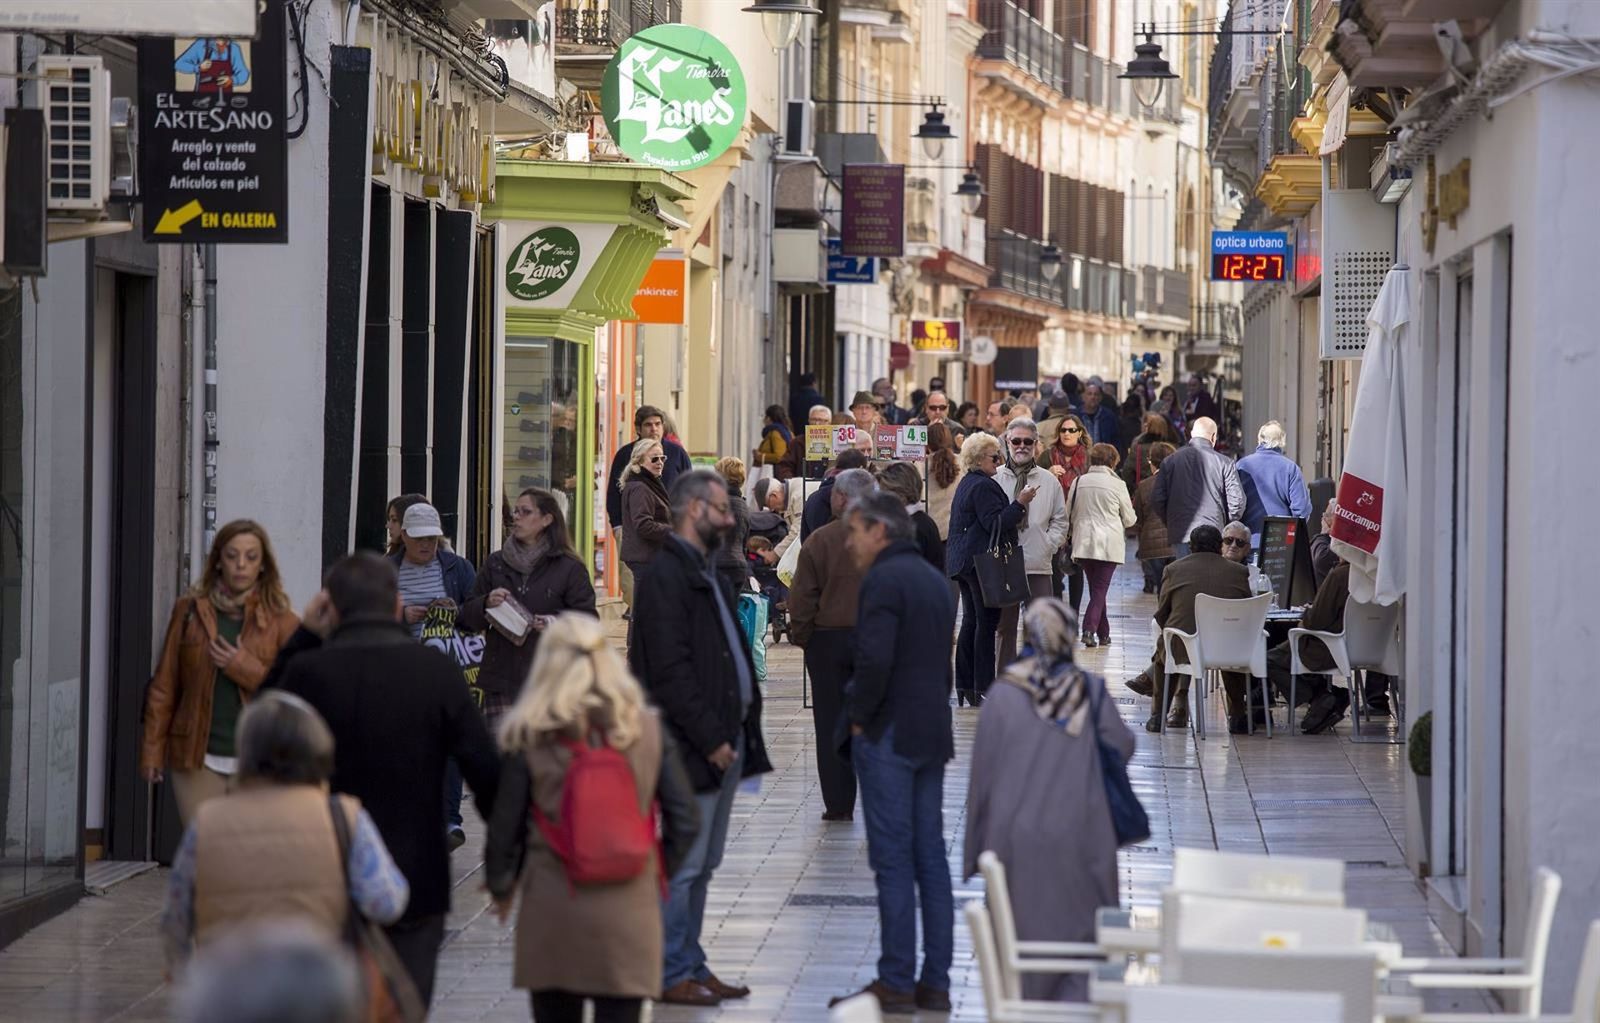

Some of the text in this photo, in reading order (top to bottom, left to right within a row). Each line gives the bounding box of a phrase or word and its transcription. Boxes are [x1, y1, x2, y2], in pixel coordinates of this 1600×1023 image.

[686, 61, 732, 79] Tiendas
[156, 92, 181, 109] EL
[154, 107, 273, 133] ARTESANO
[171, 138, 257, 156] Arreglo y venta
[182, 157, 246, 172] del calzado
[641, 151, 680, 166] Fundada
[169, 174, 260, 192] Artículos en piel
[201, 212, 277, 228] EN GALERIA
[1215, 236, 1284, 250] optica urbano
[1223, 255, 1283, 280] 12:27
[1334, 503, 1380, 532] Cruzcampo
